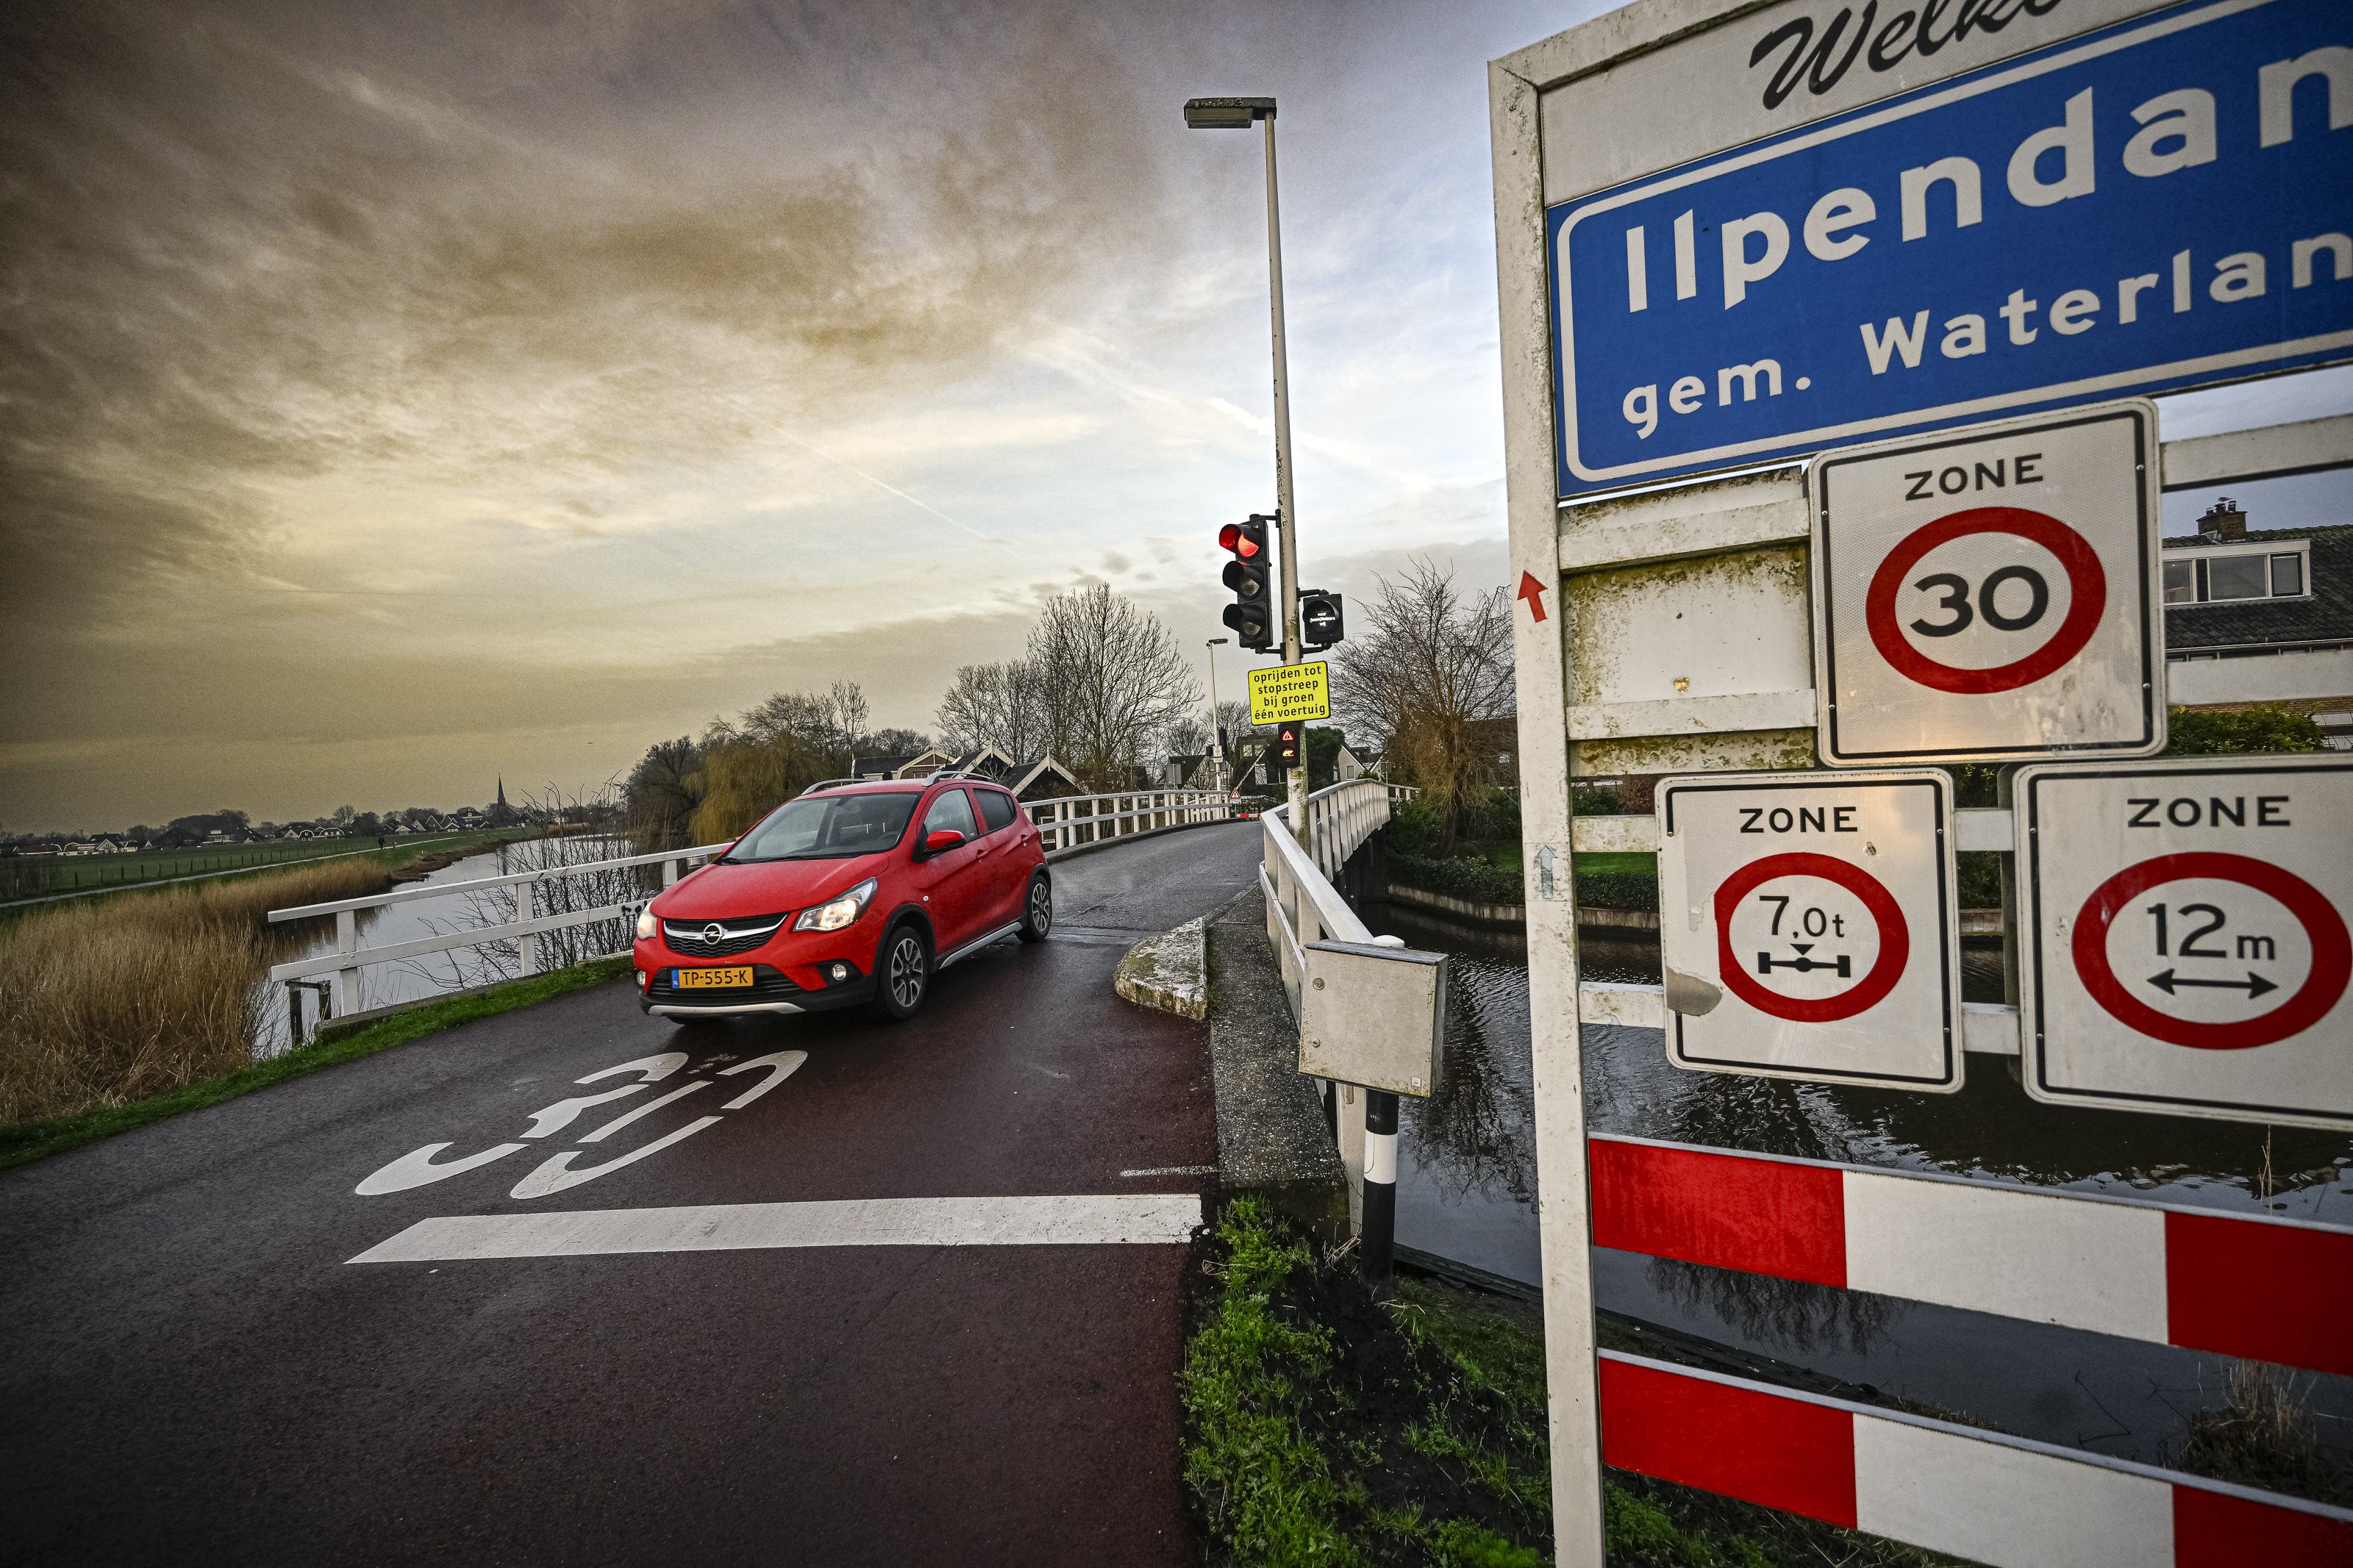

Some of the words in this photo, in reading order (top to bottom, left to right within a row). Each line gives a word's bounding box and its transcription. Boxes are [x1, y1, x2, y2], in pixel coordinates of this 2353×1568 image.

[1621, 357, 1811, 440] gem.
[1904, 454, 2044, 502] ZONE
[1910, 565, 2049, 639] 30
[1254, 669, 1300, 684] oprijden
[1304, 665, 1321, 676] tot
[1258, 680, 1318, 695] stopstreep
[1254, 709, 1274, 719] één
[1277, 704, 1325, 717] voertuig
[1264, 695, 1277, 708] bij
[1282, 693, 1314, 706] groen
[1739, 806, 1858, 833] ZONE
[2127, 795, 2290, 828] ZONE
[682, 970, 748, 985] TP-555-K
[355, 1050, 808, 1200] 30
